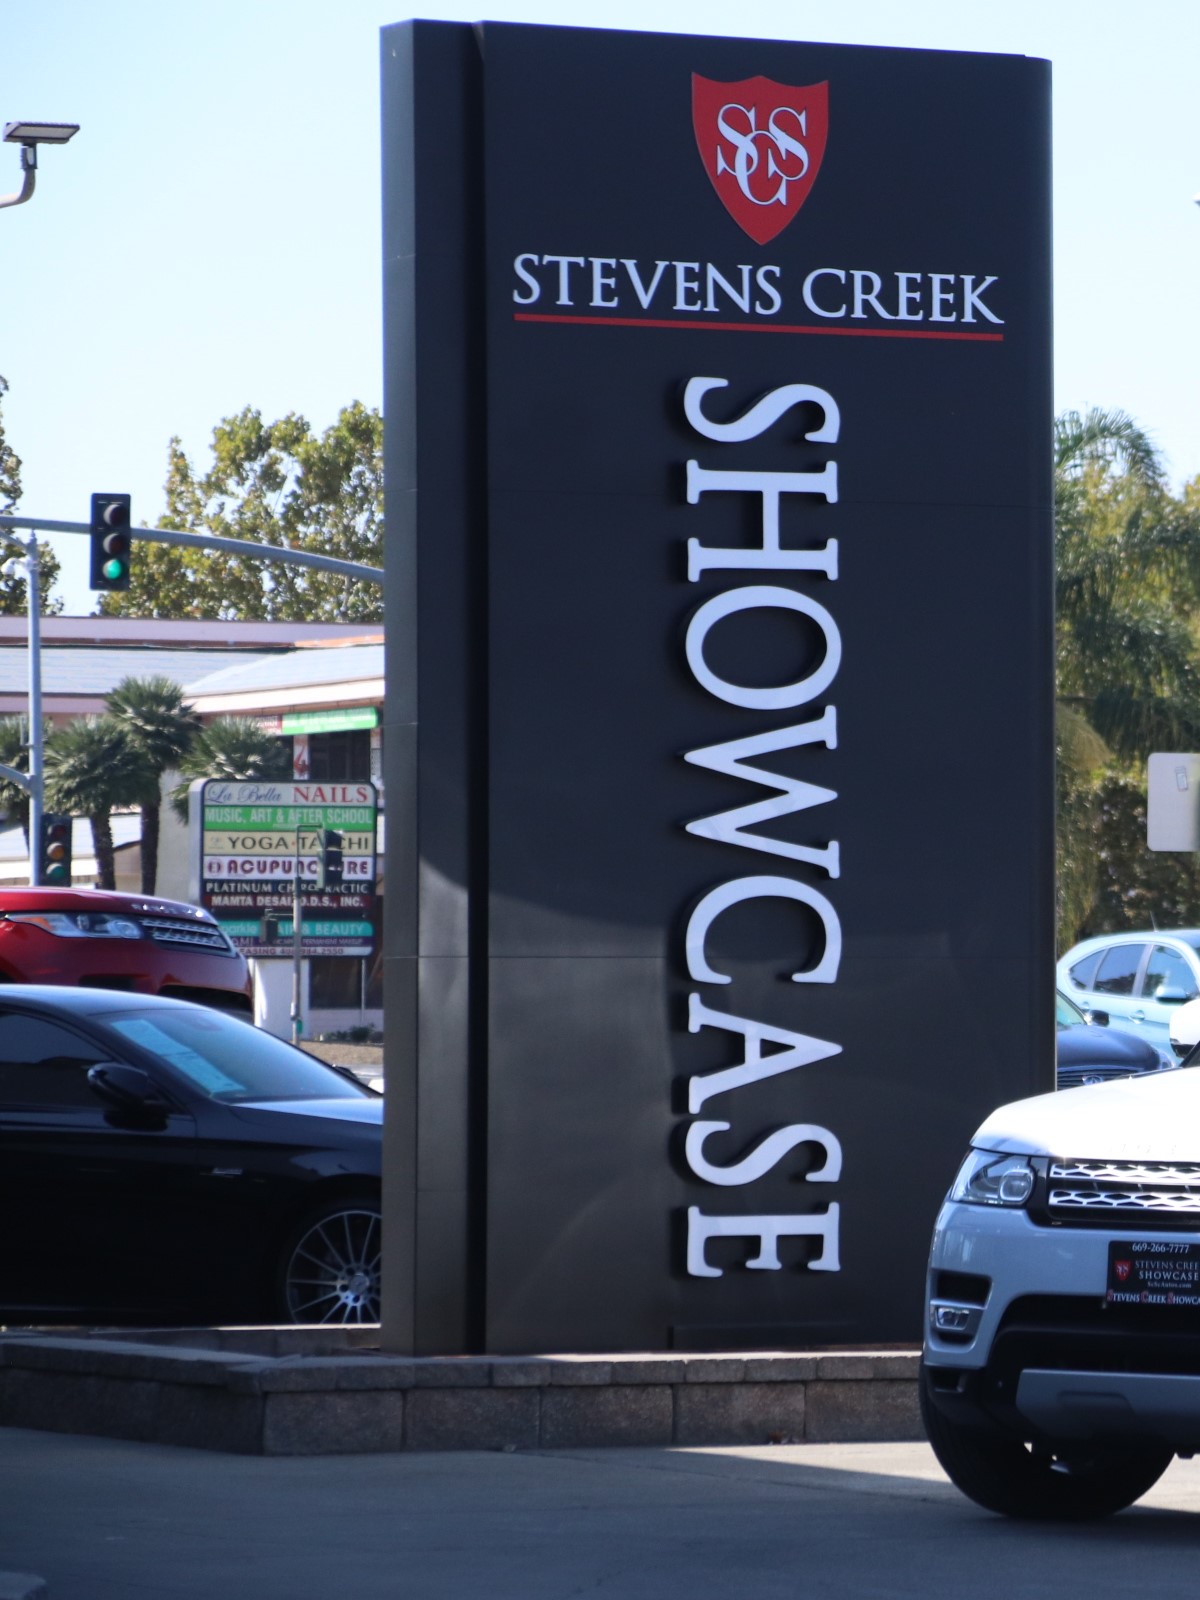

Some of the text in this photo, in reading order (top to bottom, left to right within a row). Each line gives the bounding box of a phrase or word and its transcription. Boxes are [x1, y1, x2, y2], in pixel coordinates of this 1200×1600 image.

[512, 253, 1005, 325] STEVENS CREEK
[207, 784, 369, 803] La Bella NAILS
[205, 809, 372, 824] MUSIC, ART & AFTER SCHOOL
[683, 376, 844, 1279] SHOWCASE
[228, 836, 289, 850] YOGA
[227, 859, 369, 874] ACUPUNCRE
[206, 883, 272, 893] PLATINUM
[211, 896, 255, 907] MAMTA
[340, 896, 364, 907] INC.
[315, 923, 363, 935] BEAUTY
[239, 947, 276, 955] EASING
[1132, 1243, 1190, 1254] 669-266-7777
[1134, 1261, 1174, 1270] STEVENS
[1138, 1271, 1200, 1281] SHOWCASE
